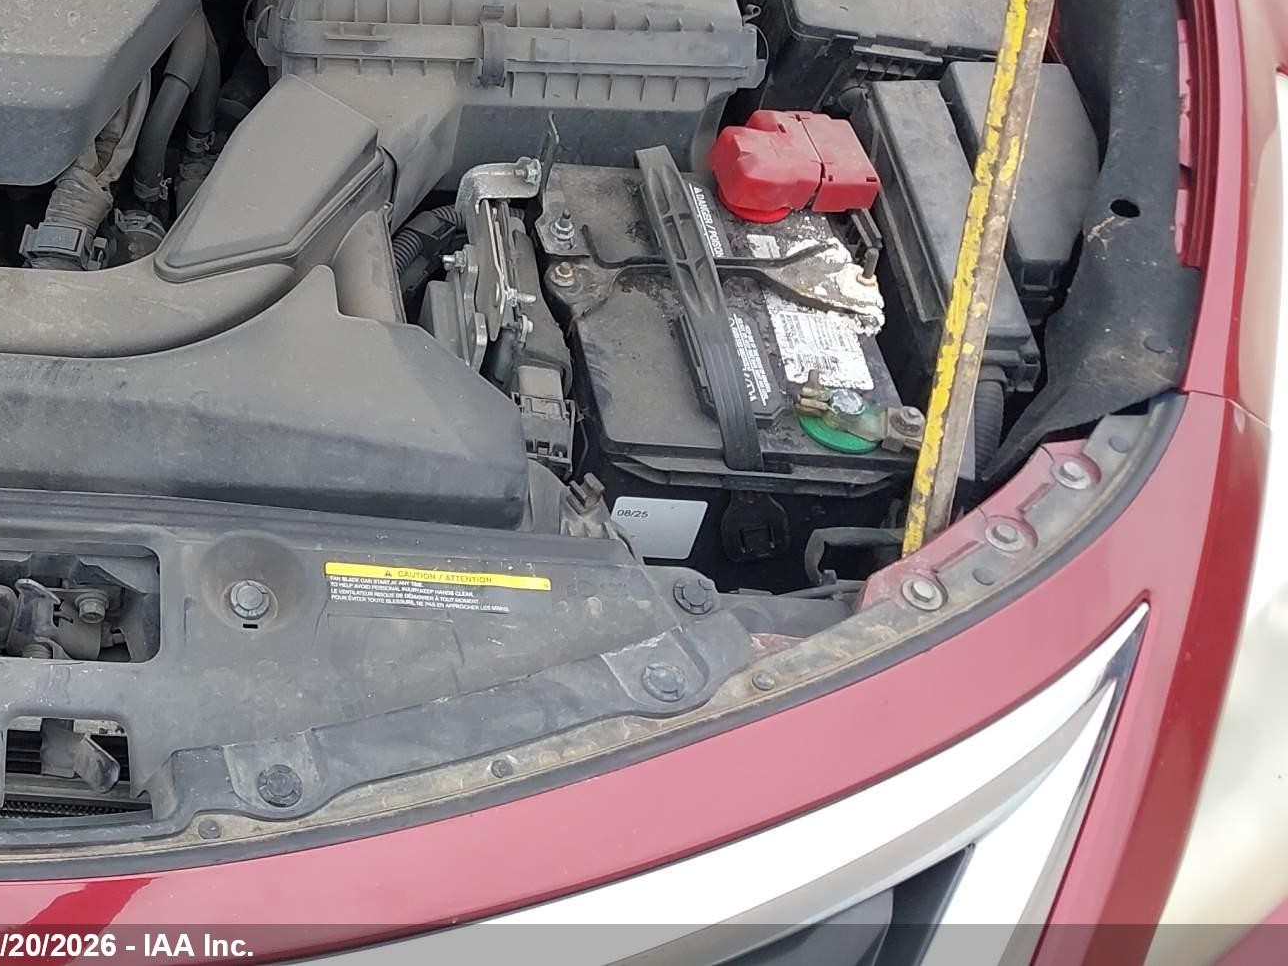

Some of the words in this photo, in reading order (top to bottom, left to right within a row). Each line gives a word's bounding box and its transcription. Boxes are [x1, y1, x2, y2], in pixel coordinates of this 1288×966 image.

[696, 193, 714, 225] DANGER
[708, 228, 725, 258] POISON
[617, 509, 649, 518] 08/25
[398, 570, 436, 580] CAUTION
[445, 574, 492, 583] ATTENTION
